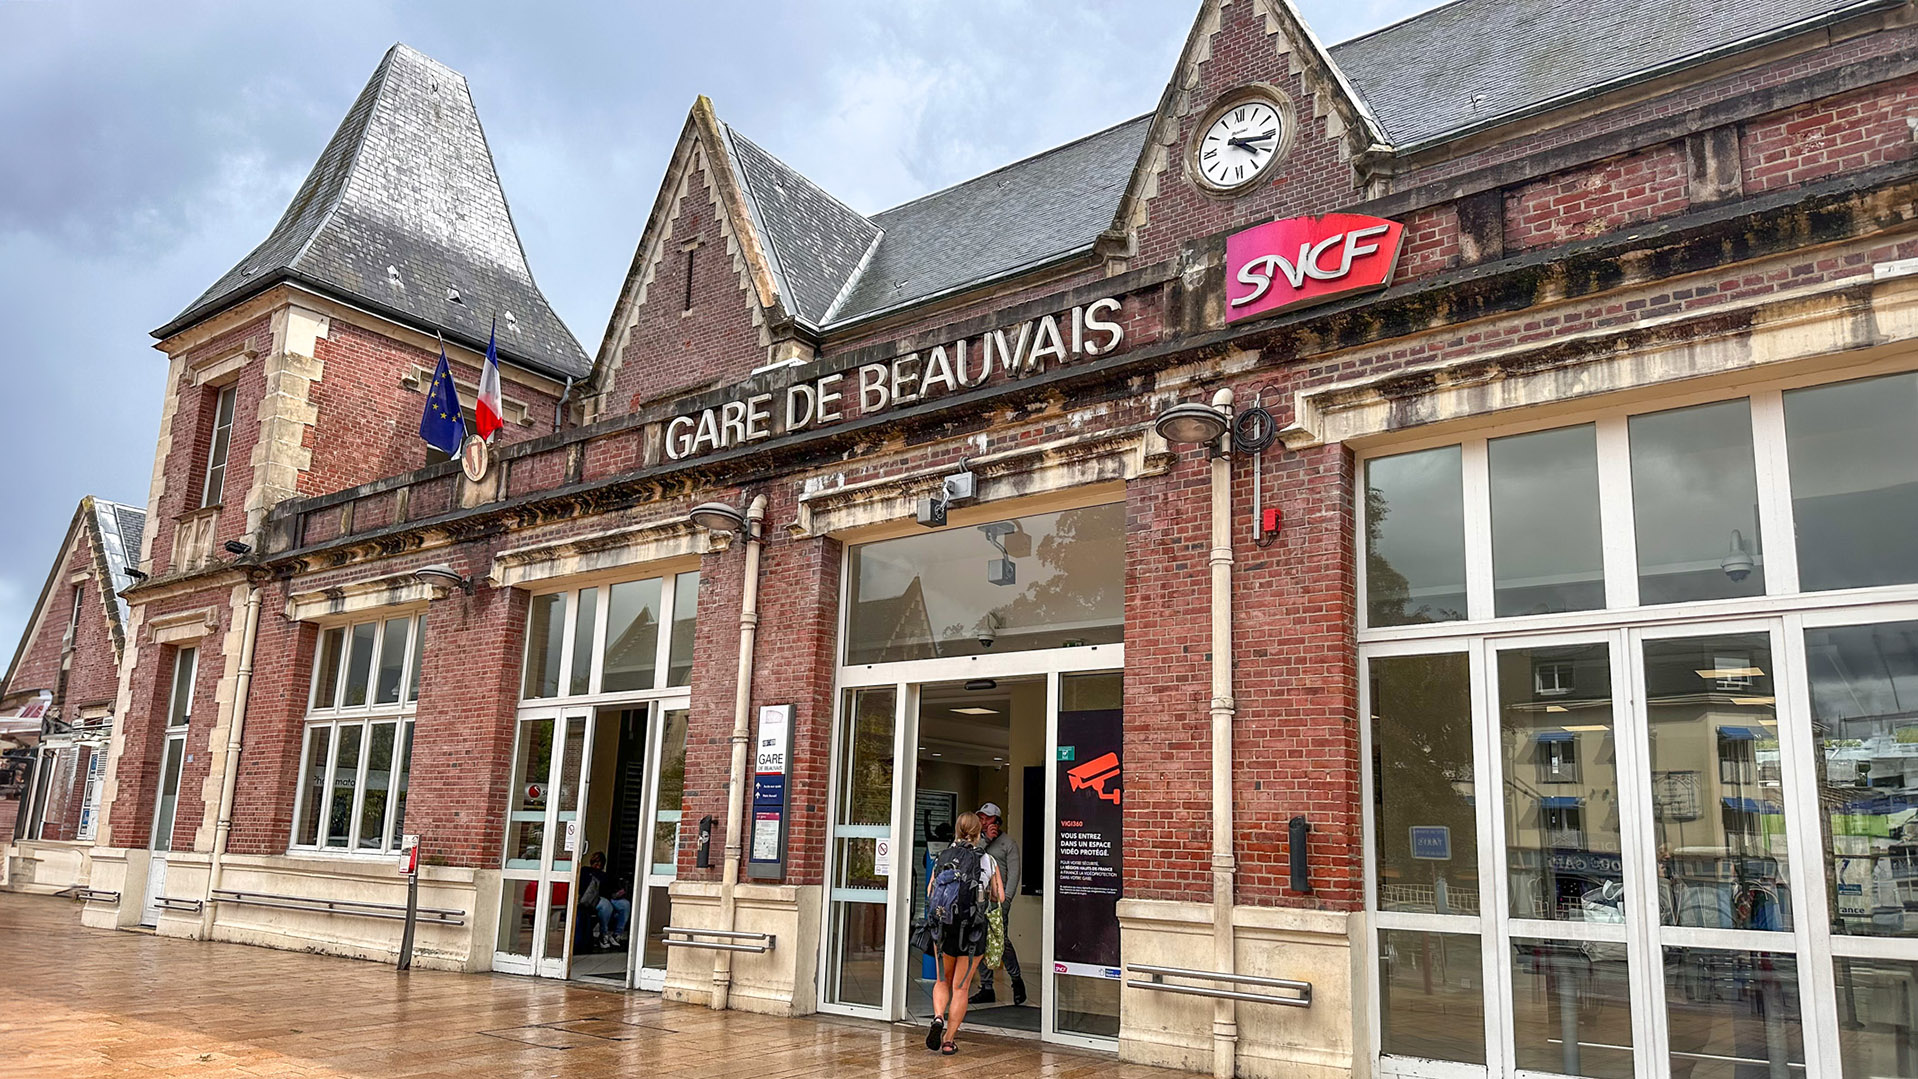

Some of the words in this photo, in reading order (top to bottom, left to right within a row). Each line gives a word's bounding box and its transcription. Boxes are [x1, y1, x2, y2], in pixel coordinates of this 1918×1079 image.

[1231, 224, 1389, 308] SNCF
[665, 393, 772, 460] GARE
[785, 373, 845, 433] DE
[858, 297, 1125, 414] BEAUVAIS
[758, 753, 783, 765] GARE
